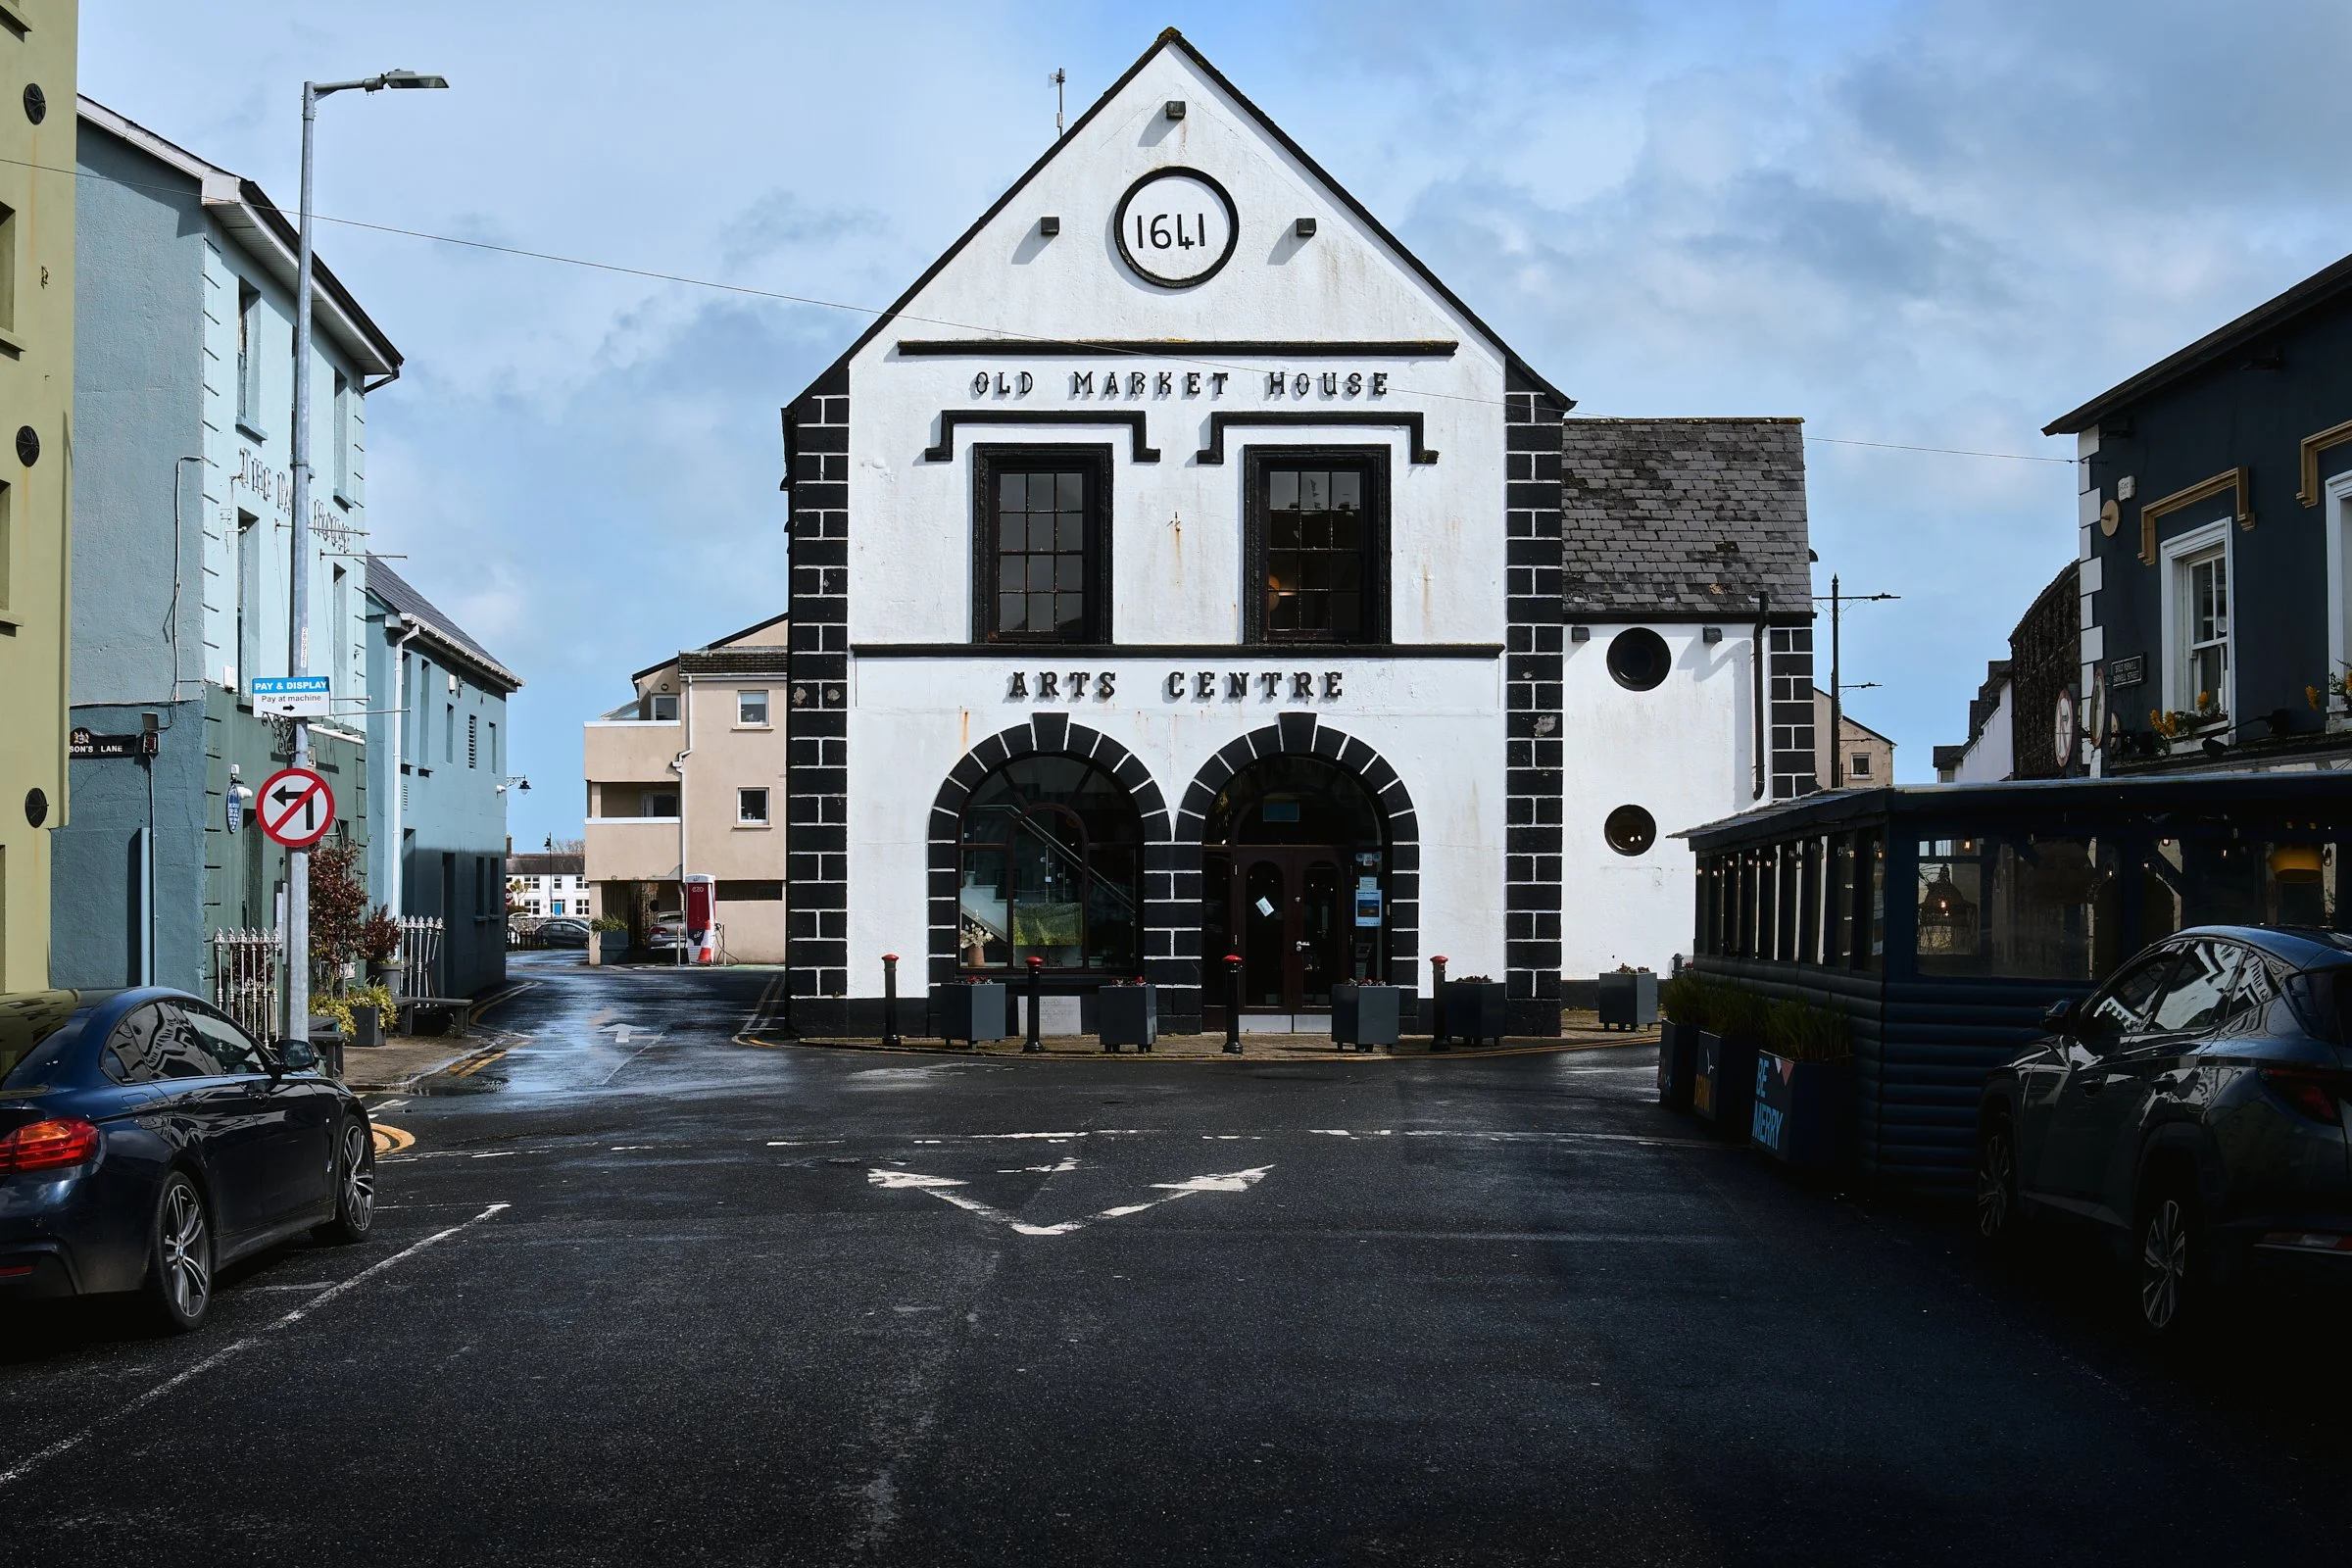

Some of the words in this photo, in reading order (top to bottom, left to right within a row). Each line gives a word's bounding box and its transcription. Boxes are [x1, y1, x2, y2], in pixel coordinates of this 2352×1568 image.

[1137, 213, 1205, 251] 1641
[974, 370, 1033, 395] OLD
[1072, 370, 1229, 395] MARKET
[1268, 371, 1388, 396] HOUSE
[239, 448, 271, 501] THE
[286, 681, 327, 690] DISPLAY
[1008, 671, 1116, 700] ARTS
[1167, 671, 1343, 699] CENTRE
[1755, 1057, 1770, 1098] BE
[1751, 1100, 1784, 1151] MERRY
